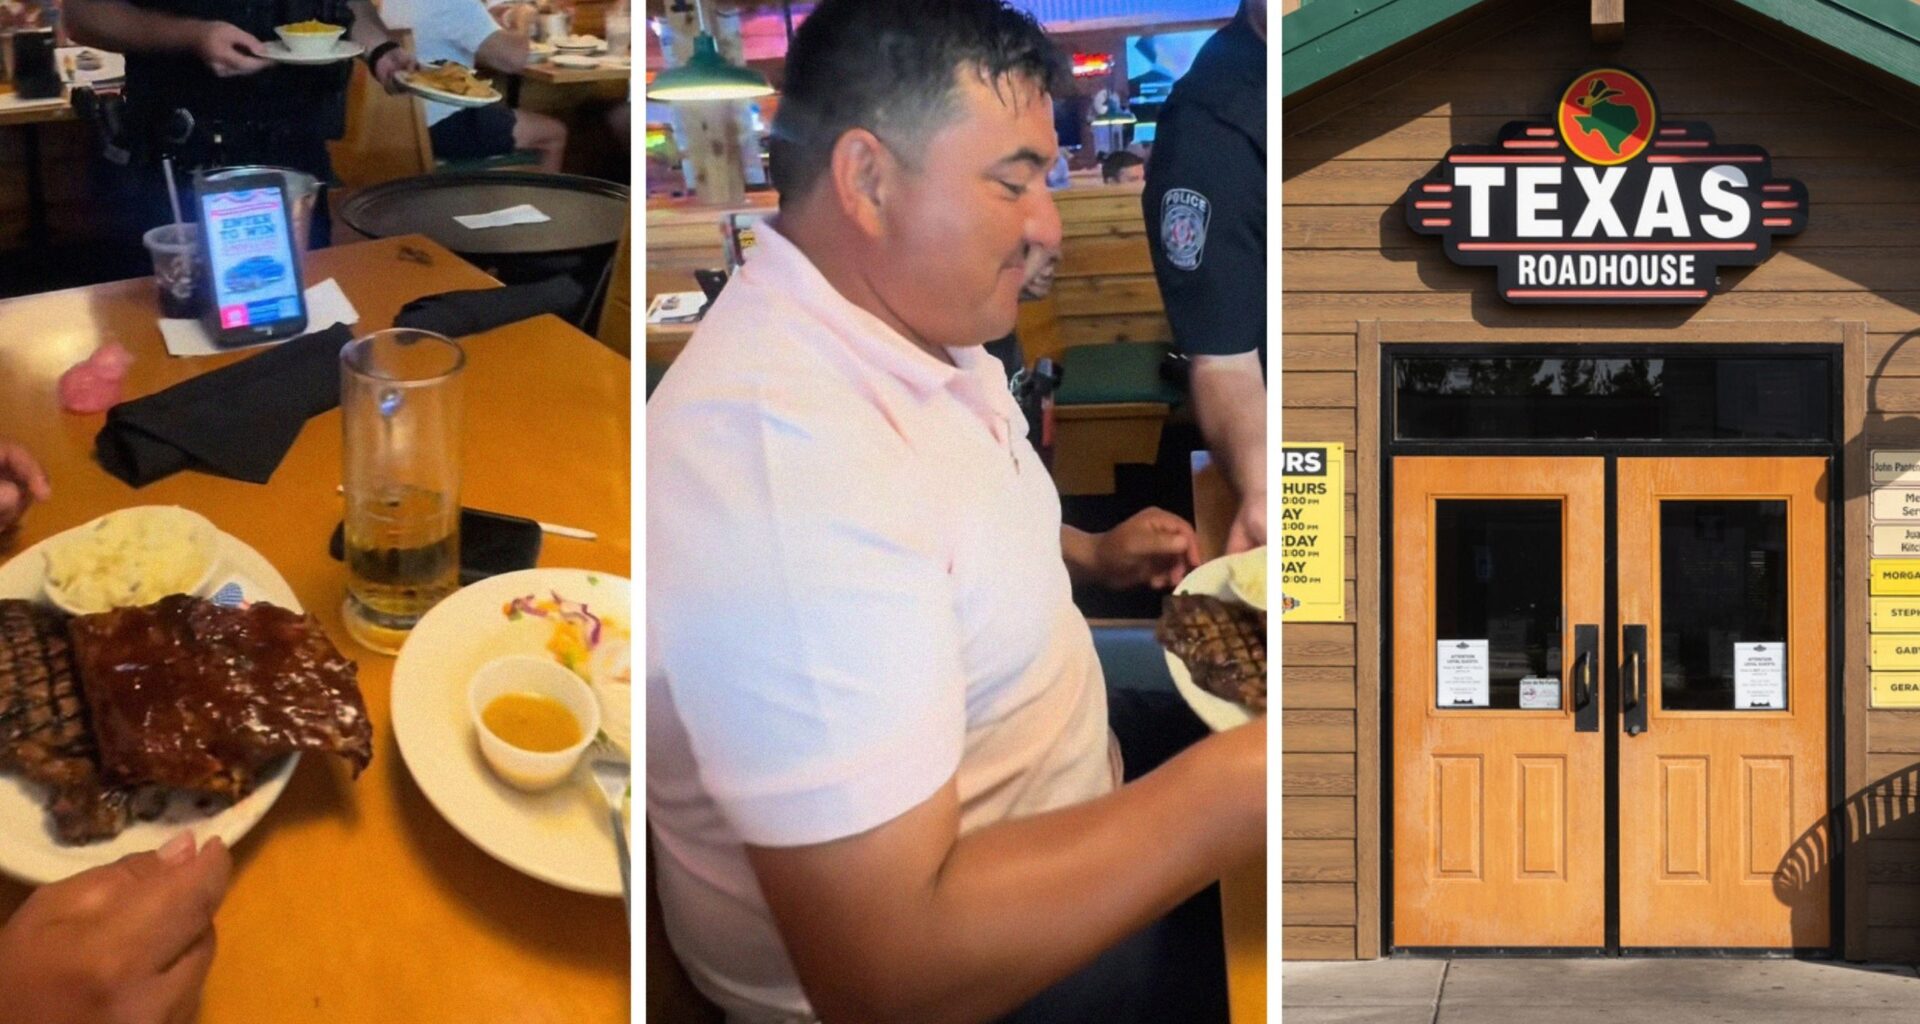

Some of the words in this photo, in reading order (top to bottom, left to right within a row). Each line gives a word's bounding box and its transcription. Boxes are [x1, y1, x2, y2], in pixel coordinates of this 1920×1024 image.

[1165, 192, 1207, 212] POLICE
[1454, 165, 1751, 239] TEXAS
[219, 228, 239, 240] TO
[244, 222, 276, 238] WIN
[1518, 254, 1695, 286] ROADHOUSE
[1875, 462, 1893, 472] John
[1282, 483, 1327, 495] HURS
[1282, 535, 1318, 547] DAY
[1901, 543, 1920, 552] Kitc
[1890, 683, 1920, 692] GERA
